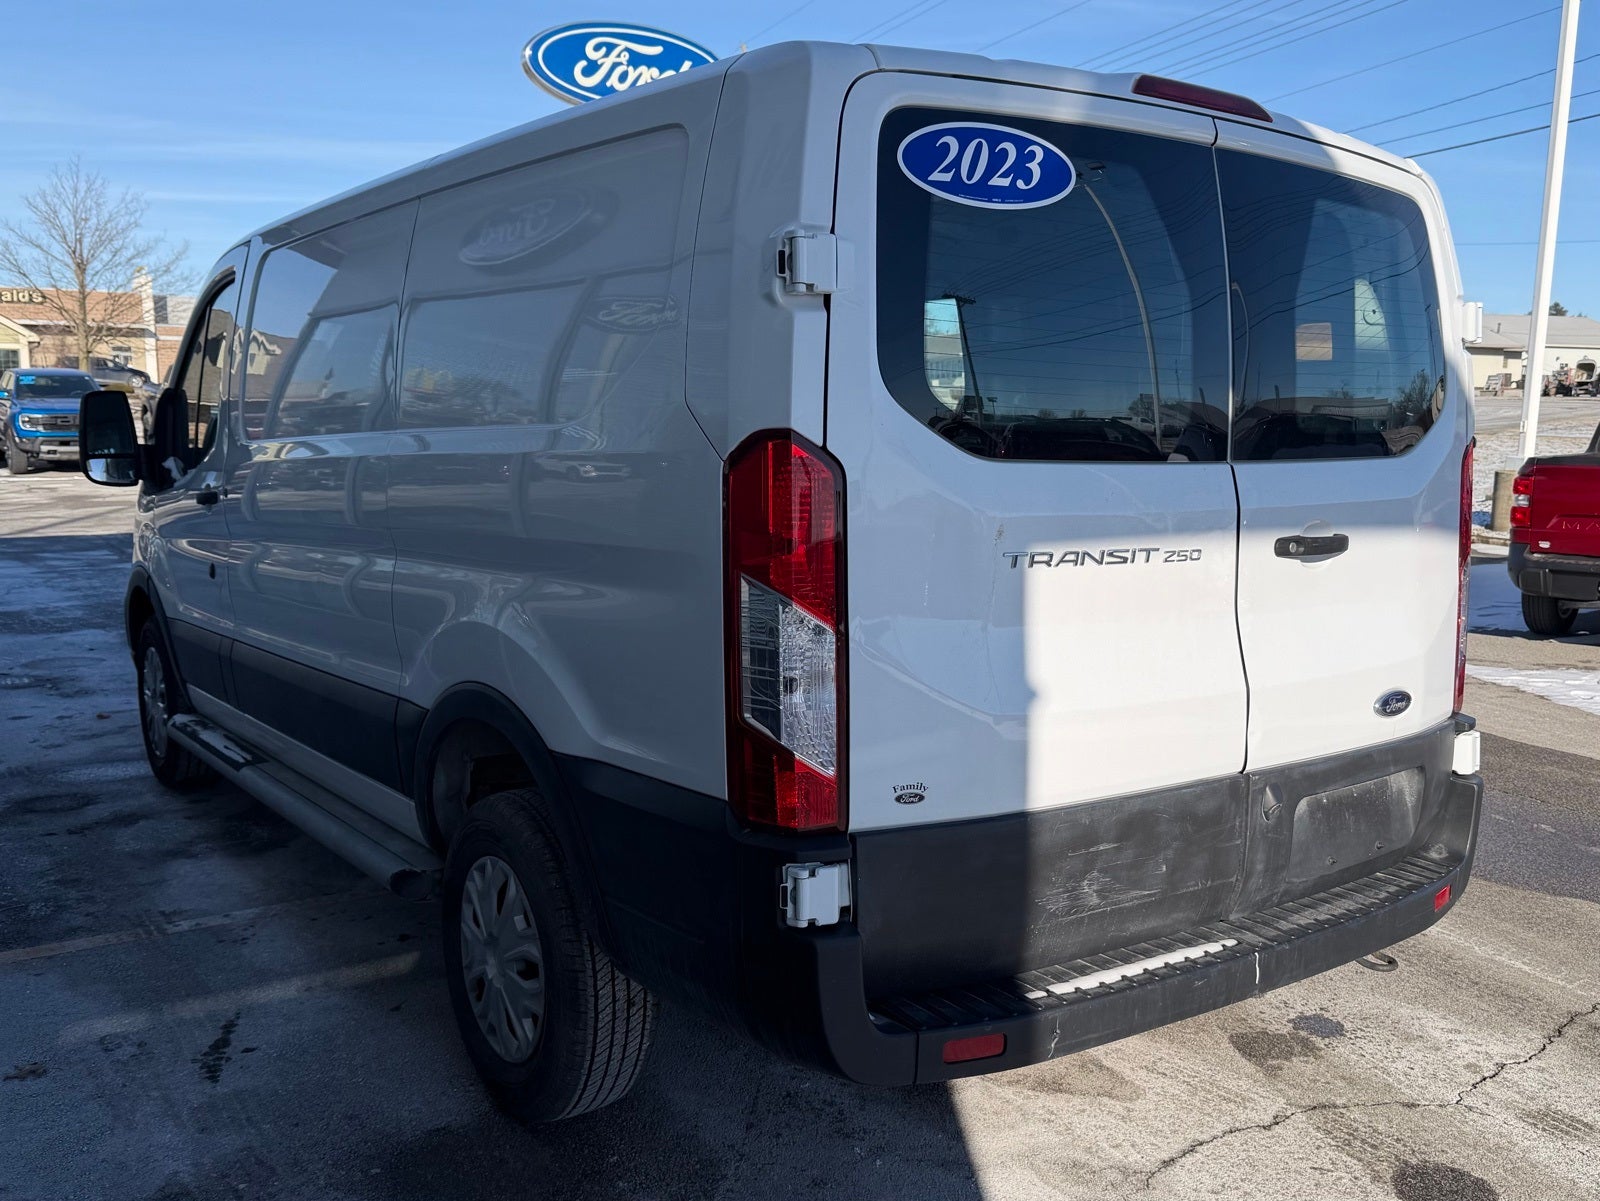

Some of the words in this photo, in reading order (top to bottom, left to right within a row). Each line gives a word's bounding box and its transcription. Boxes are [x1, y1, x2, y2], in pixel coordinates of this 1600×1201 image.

[927, 135, 1044, 190] 2023
[1002, 548, 1160, 569] TRANSIT
[1163, 548, 1202, 563] 250
[1385, 695, 1408, 713] Ford
[892, 781, 929, 793] Family
[900, 793, 920, 803] Ford
